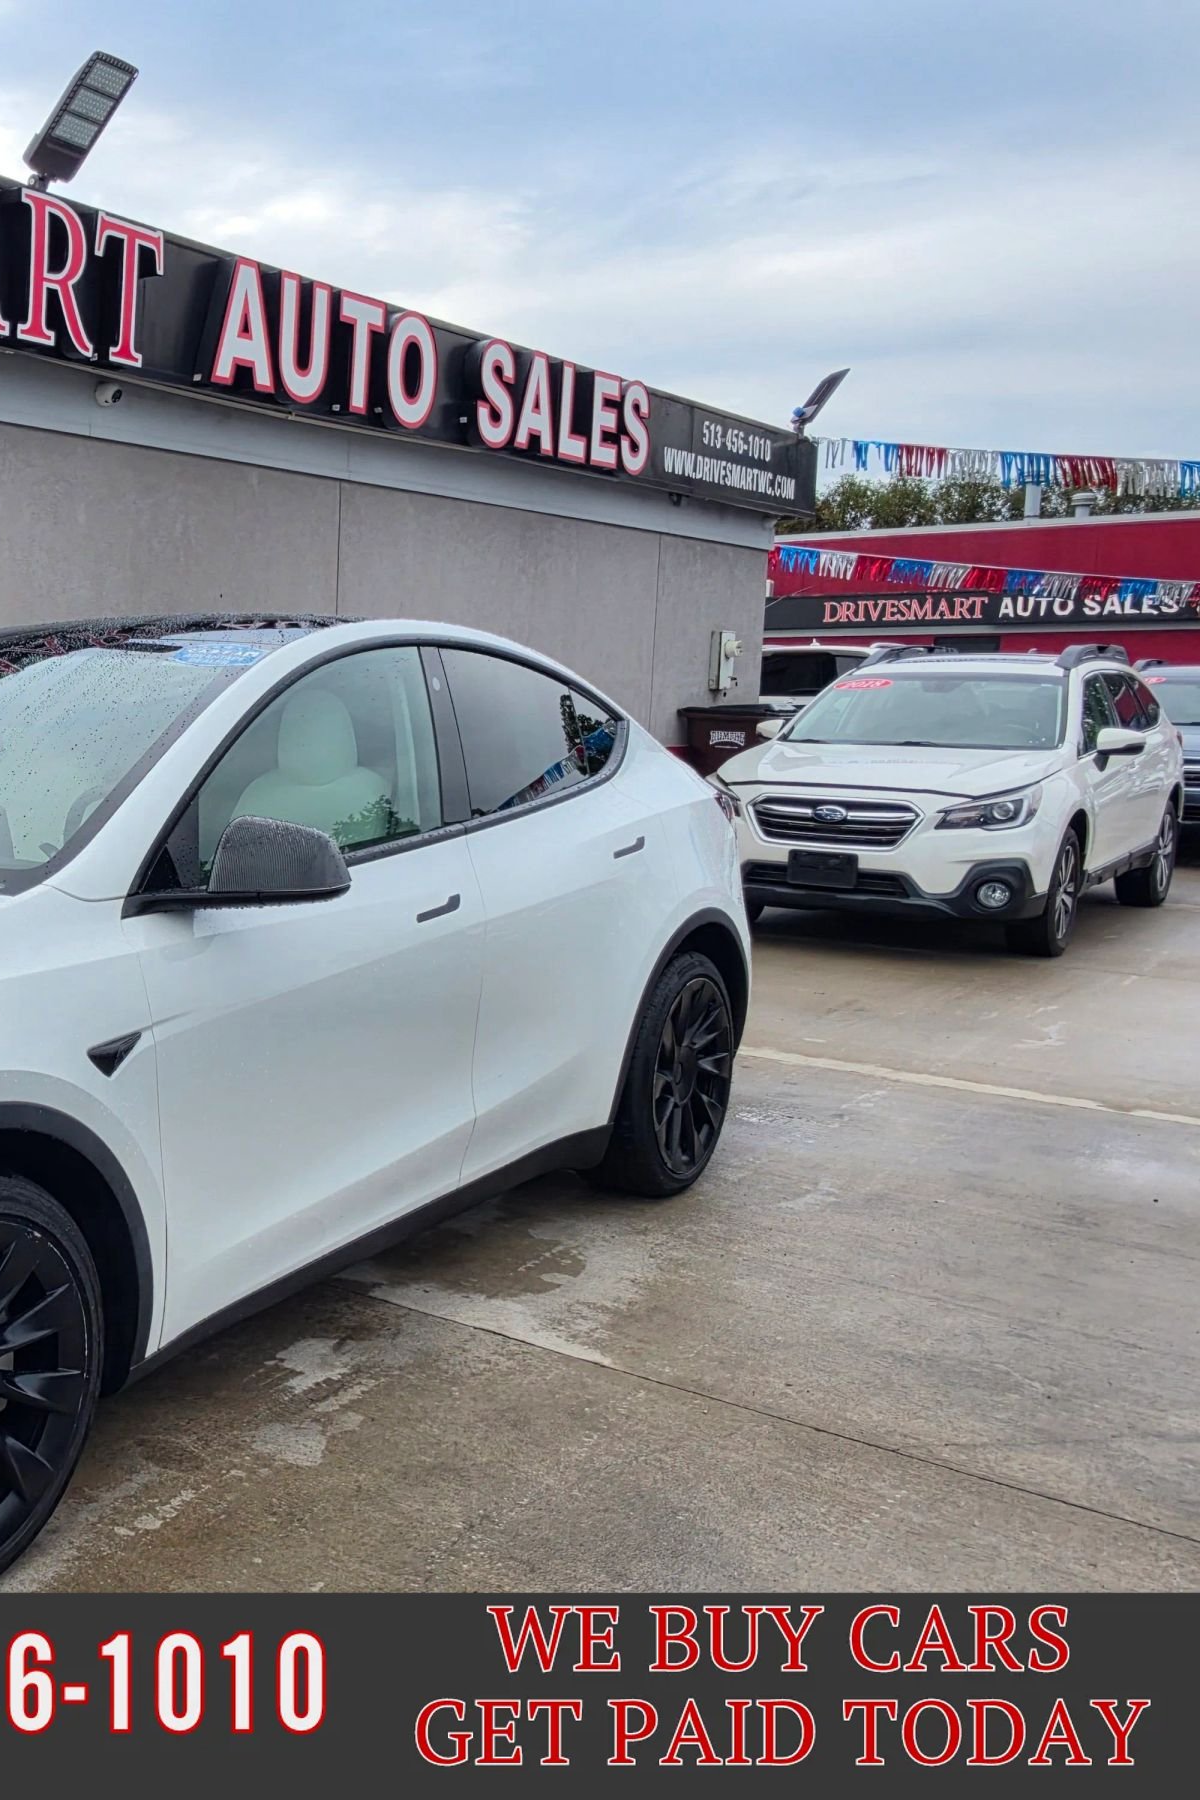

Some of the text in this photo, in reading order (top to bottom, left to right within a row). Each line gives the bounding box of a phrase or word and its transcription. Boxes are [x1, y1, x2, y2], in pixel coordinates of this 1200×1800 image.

[210, 256, 438, 430] AUTO
[476, 338, 651, 476] SALES
[702, 420, 772, 463] 513-456-1010
[663, 446, 797, 500] WWW.DRIVESMARTWC.COM
[822, 595, 989, 624] DRIVESMART
[998, 596, 1075, 619] AUTO
[1082, 593, 1180, 616] SALES
